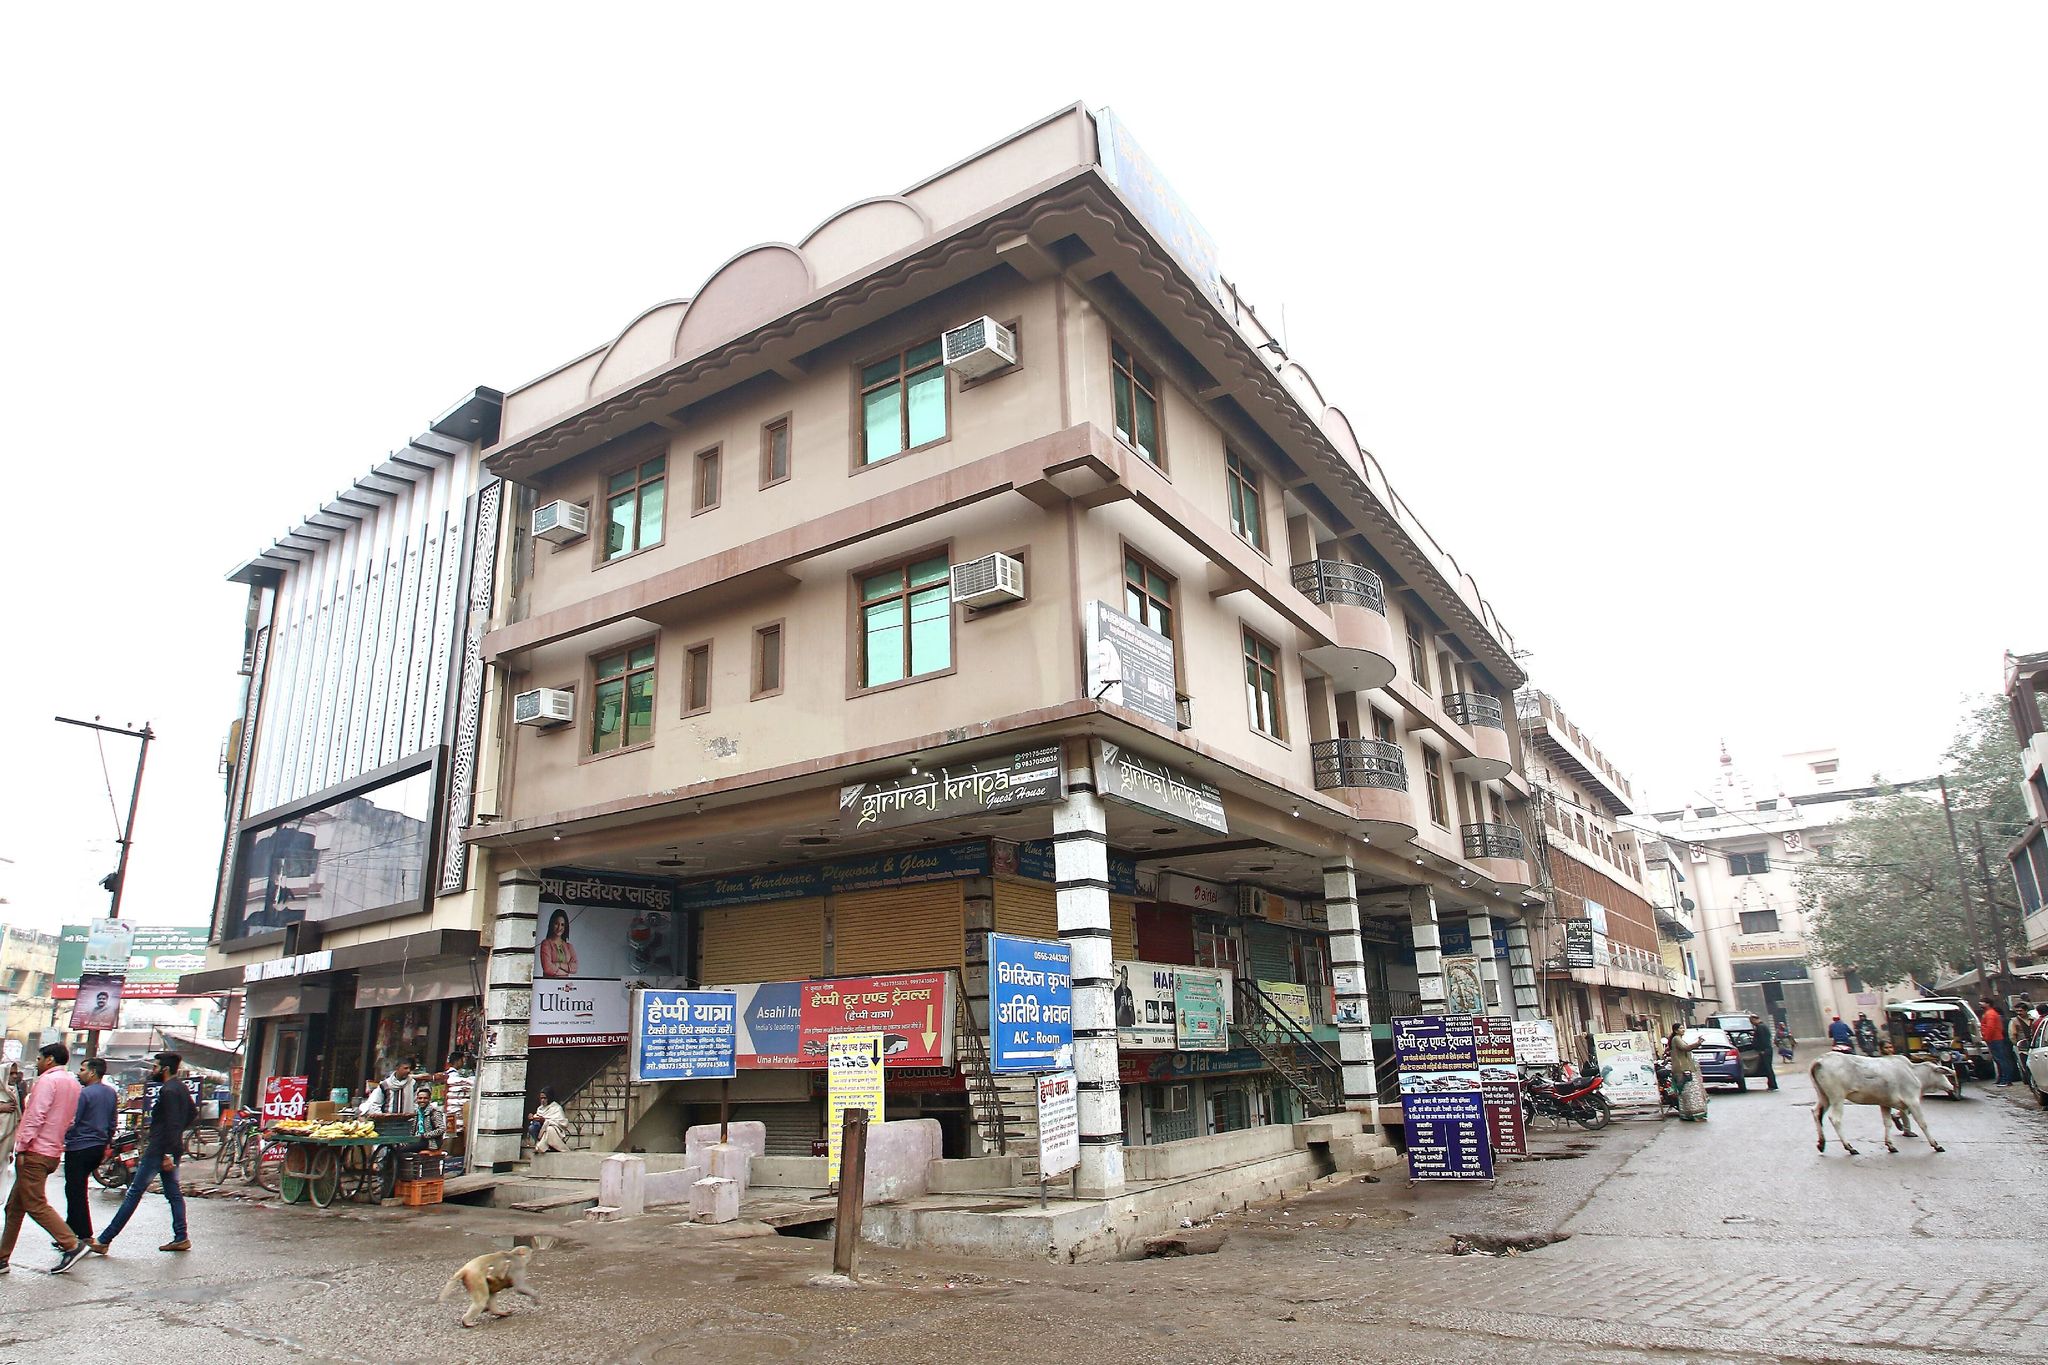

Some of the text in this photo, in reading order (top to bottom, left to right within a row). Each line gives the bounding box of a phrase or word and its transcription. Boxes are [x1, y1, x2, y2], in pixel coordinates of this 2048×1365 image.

[1118, 753, 1202, 814] giriraj kripa
[856, 774, 939, 829] giriraj
[942, 764, 1012, 805] kripa
[986, 786, 1046, 809] Guest House
[714, 878, 745, 894] Uma
[750, 871, 816, 891] Hardware,
[821, 861, 879, 882] Plywood
[883, 858, 895, 873] &
[900, 854, 940, 872] Glass
[566, 877, 624, 901] हार्डवेयर
[625, 885, 672, 909] प्लाईवुड
[1201, 888, 1218, 904] airtel
[1033, 951, 1071, 963] 0565-2443301
[997, 961, 1071, 994] गिरिराज कृपा
[538, 992, 594, 1012] Ultima
[842, 992, 859, 1010] टूर
[861, 991, 889, 1005] एण्ड
[891, 986, 932, 1006] ट्रैवल्स
[647, 996, 734, 1024] हैप्पी यात्रा
[756, 1005, 786, 1019] Asahi
[869, 1008, 894, 1021] यात्रा)
[997, 993, 1072, 1025] अतिथि भवन
[668, 1024, 677, 1035] के
[678, 1024, 694, 1035] लिये
[694, 1024, 717, 1035] सम्पर्क
[755, 1023, 772, 1031] India's
[773, 1022, 794, 1032] leading
[546, 1037, 564, 1045] UMA
[565, 1035, 607, 1044] HARDWARE
[1013, 1030, 1029, 1044] A/C
[1036, 1031, 1060, 1044] Room
[1152, 1036, 1166, 1044] UMA
[1416, 1038, 1429, 1052] टूर
[1429, 1036, 1447, 1051] एण्ड
[1445, 1032, 1473, 1051] ट्रैवल्स
[1597, 1038, 1632, 1052] करन
[757, 1055, 772, 1064] Uma
[1189, 1053, 1210, 1072] Flat
[1055, 1079, 1070, 1097] यात्रा
